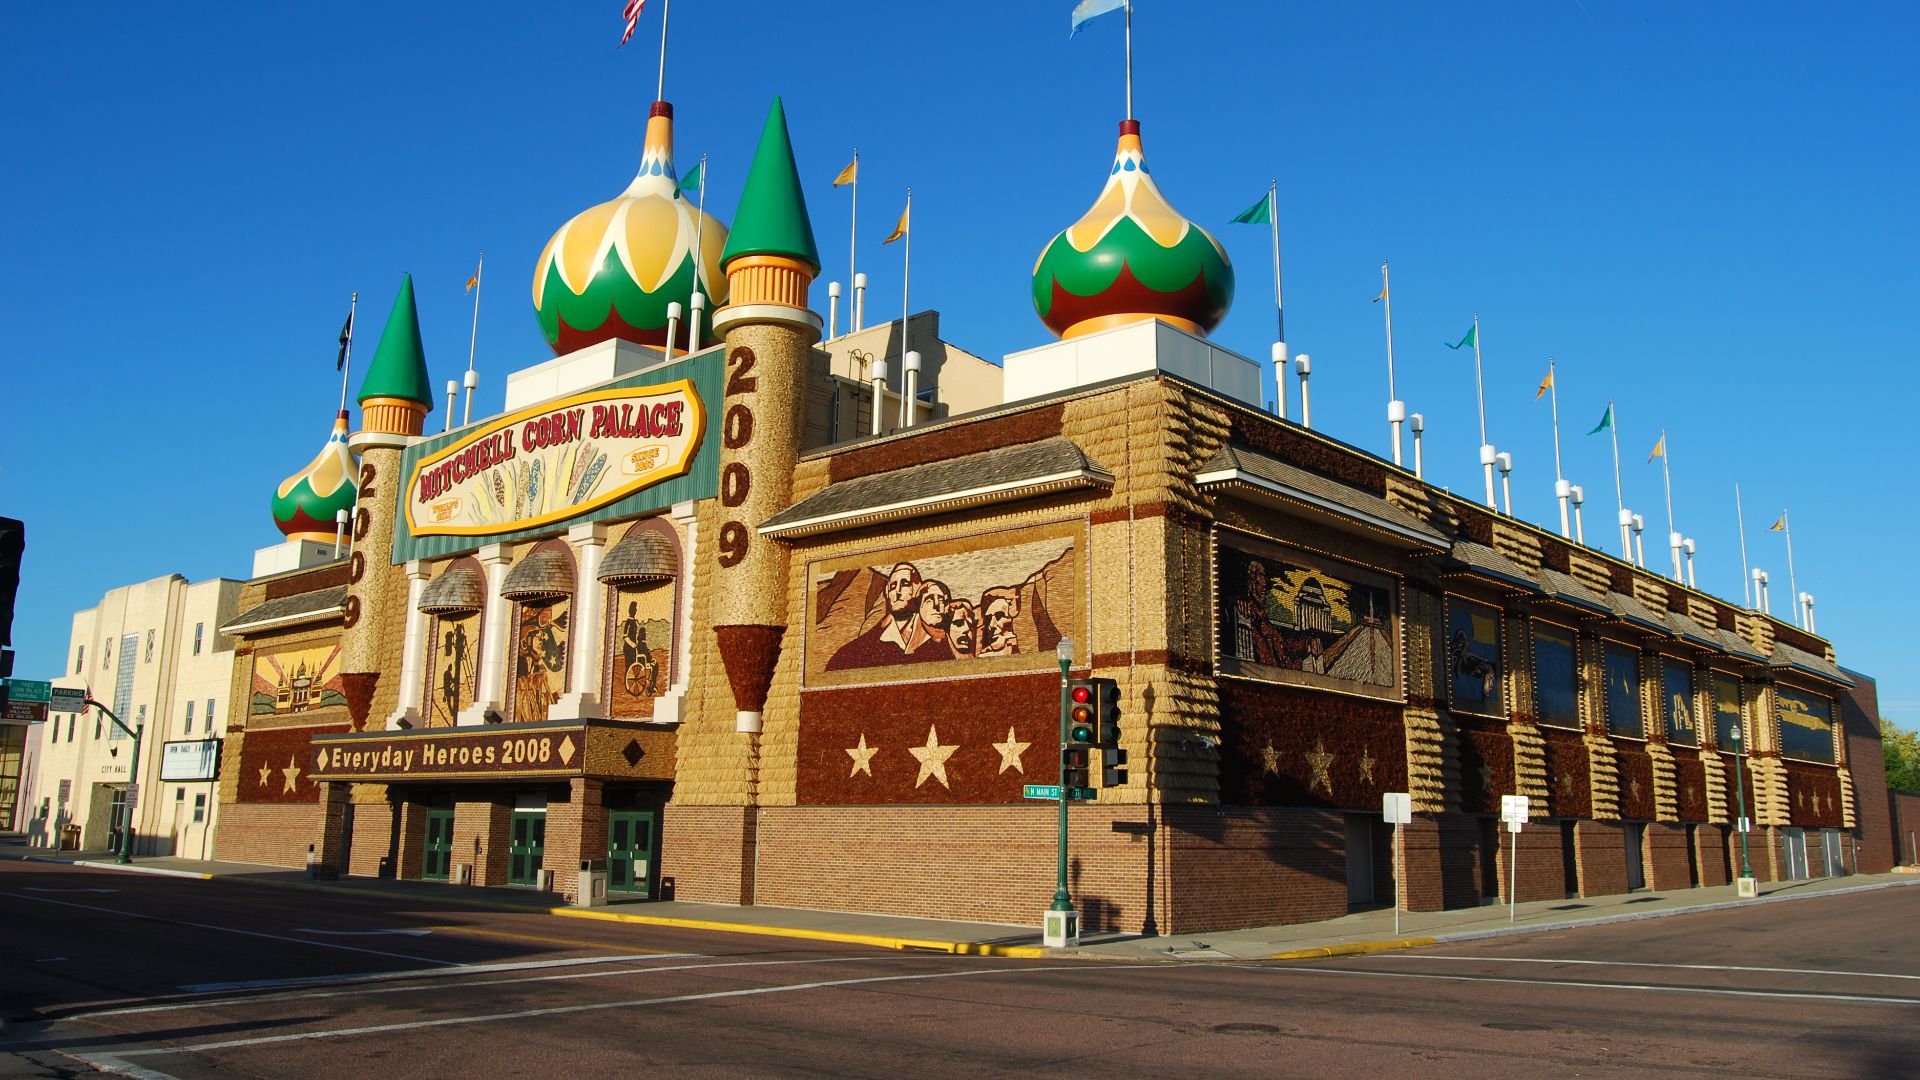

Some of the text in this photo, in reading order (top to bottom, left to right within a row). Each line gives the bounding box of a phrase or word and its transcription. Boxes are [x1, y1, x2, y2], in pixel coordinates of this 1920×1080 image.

[418, 400, 685, 505] MITCHELL CORN PALACE
[631, 447, 660, 464] SINCE
[717, 345, 758, 569] 2009
[634, 458, 655, 473] 1892
[343, 462, 377, 630] 2009
[54, 689, 83, 697] PARKING
[331, 737, 551, 773] Everyday Heroes 2008
[101, 765, 127, 774] CITY HALL
[1030, 787, 1058, 798] N MAIN ST
